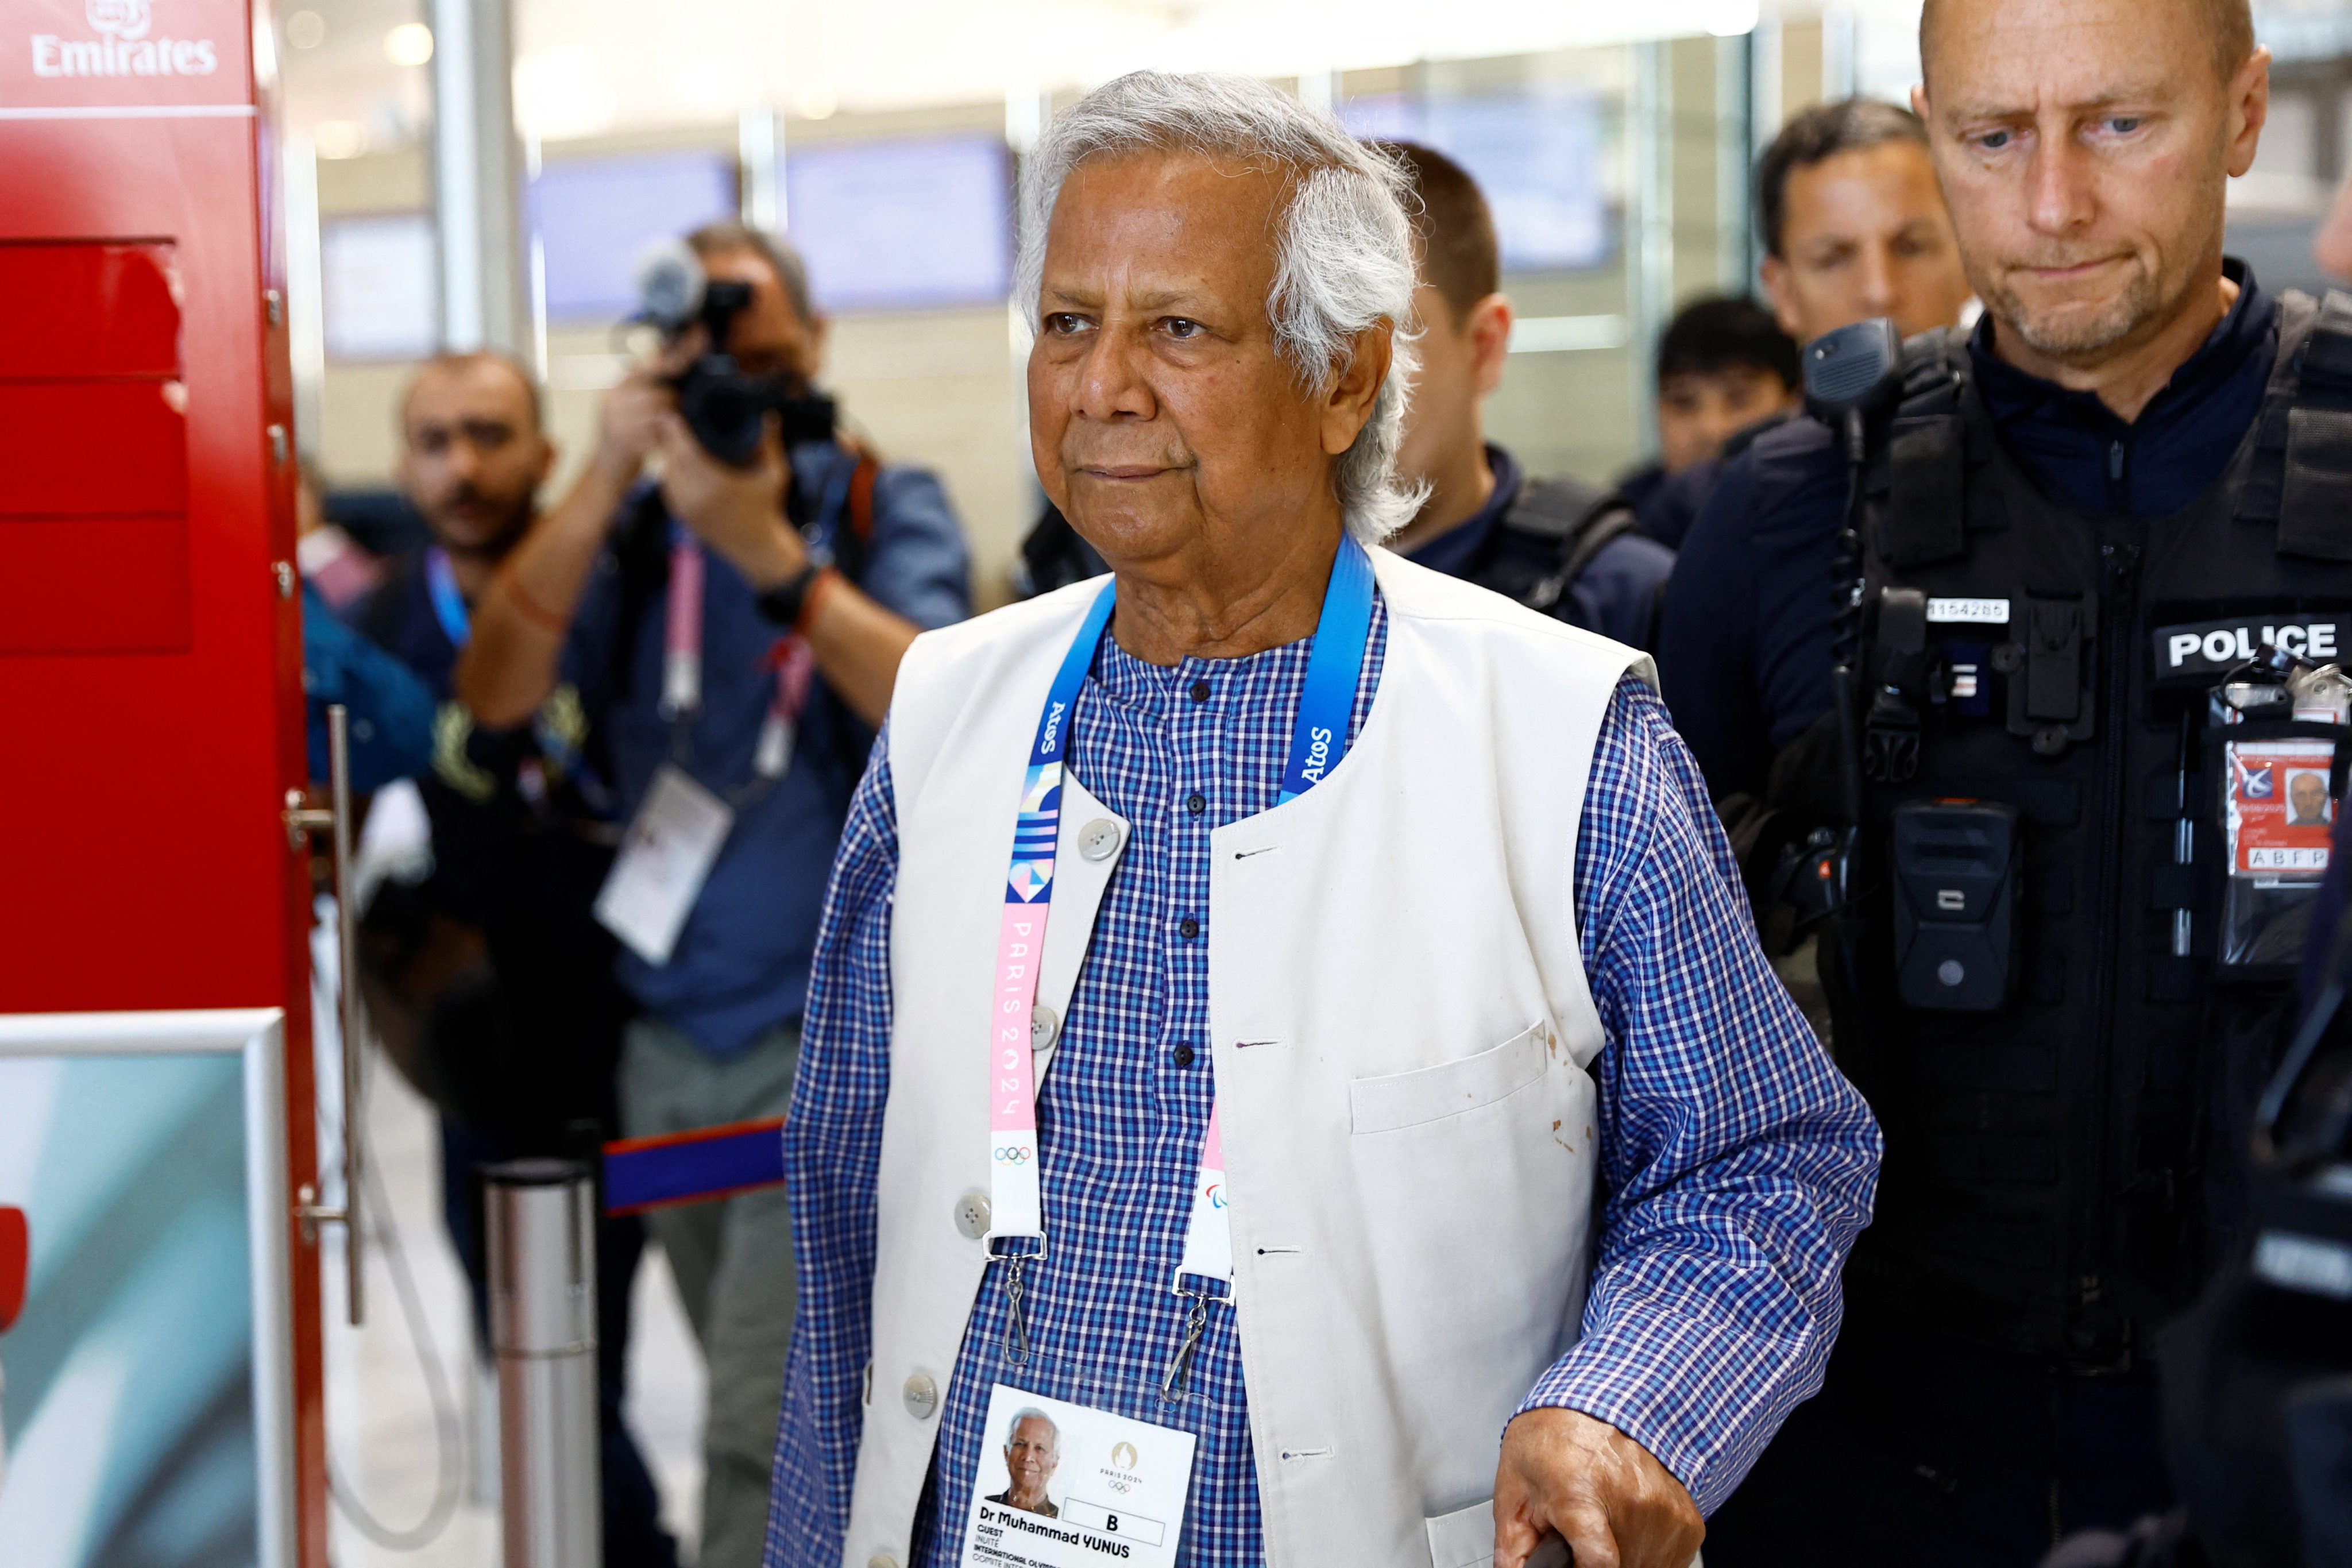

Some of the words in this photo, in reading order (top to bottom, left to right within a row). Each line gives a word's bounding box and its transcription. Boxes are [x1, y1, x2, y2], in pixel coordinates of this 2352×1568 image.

[30, 33, 217, 77] Emirates
[2169, 623, 2338, 667] POLICE
[1041, 701, 1066, 755] Atos
[1301, 726, 1332, 784] Atos
[1003, 922, 1032, 1014] PARIS
[1001, 1027, 1021, 1114] 2024
[1100, 1468, 1121, 1479] PARIS
[1123, 1474, 1142, 1484] 2024
[977, 1524, 1003, 1538] GUEST
[980, 1506, 995, 1521] Dr
[998, 1511, 1080, 1545] Muhammad
[1083, 1534, 1130, 1559] YUNUS
[1106, 1514, 1118, 1532] B
[974, 1543, 1027, 1565] INTERNATIONAL
